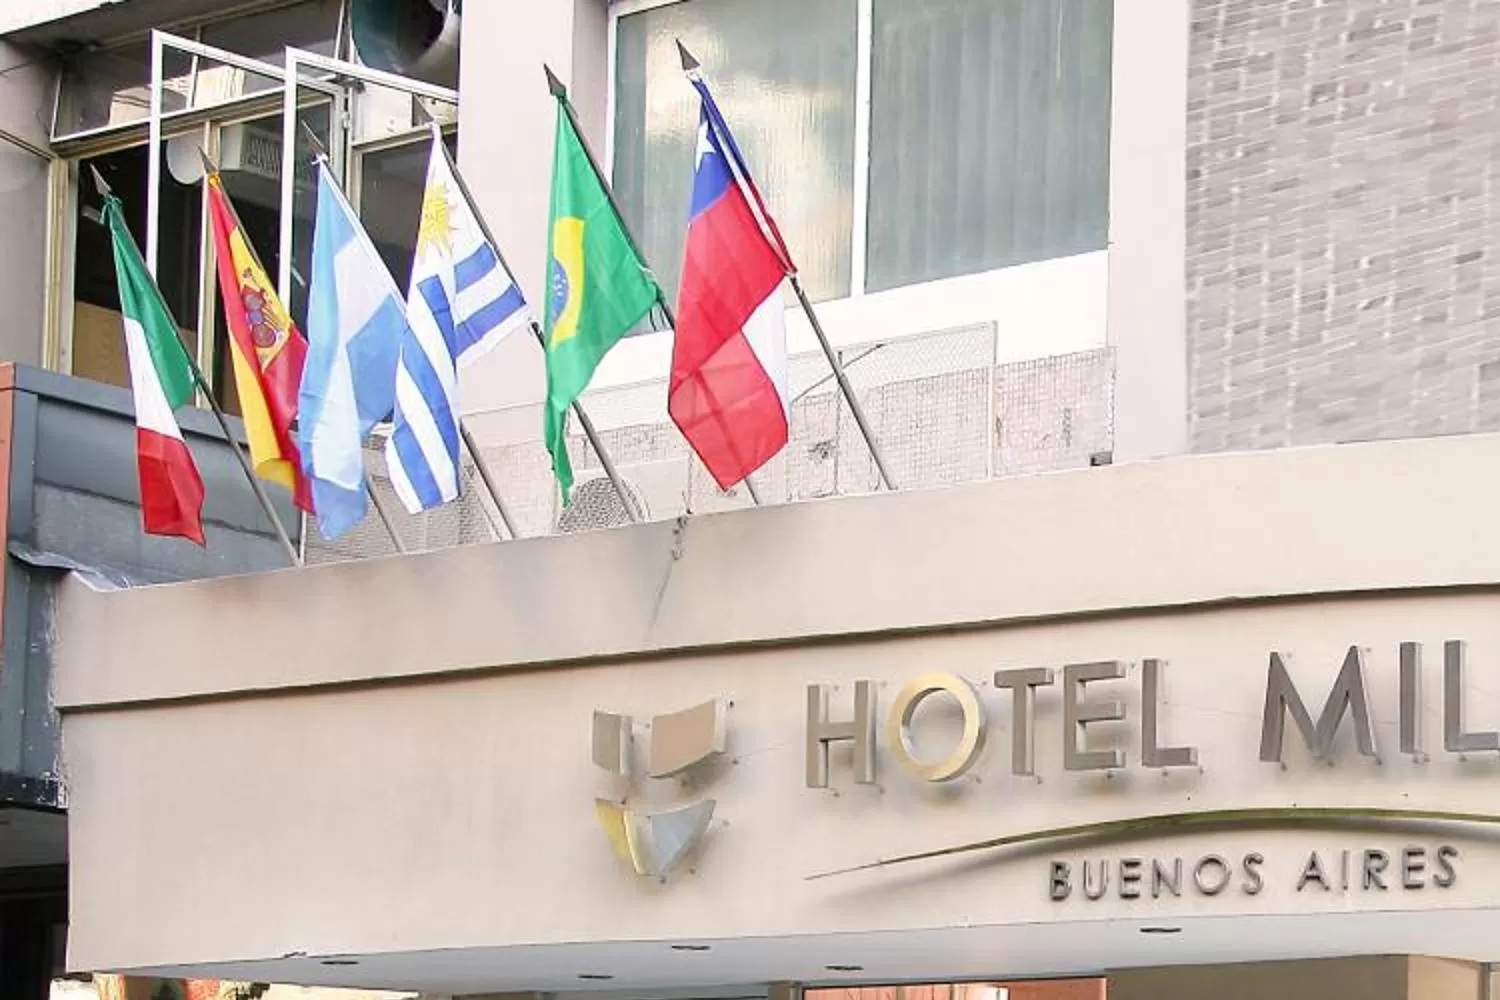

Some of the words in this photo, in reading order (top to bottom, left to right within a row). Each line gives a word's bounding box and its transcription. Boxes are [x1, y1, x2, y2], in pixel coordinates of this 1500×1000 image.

[805, 657, 1198, 789] HOTEL
[1048, 853, 1265, 901] BUENOS
[1296, 845, 1460, 894] AIRES
